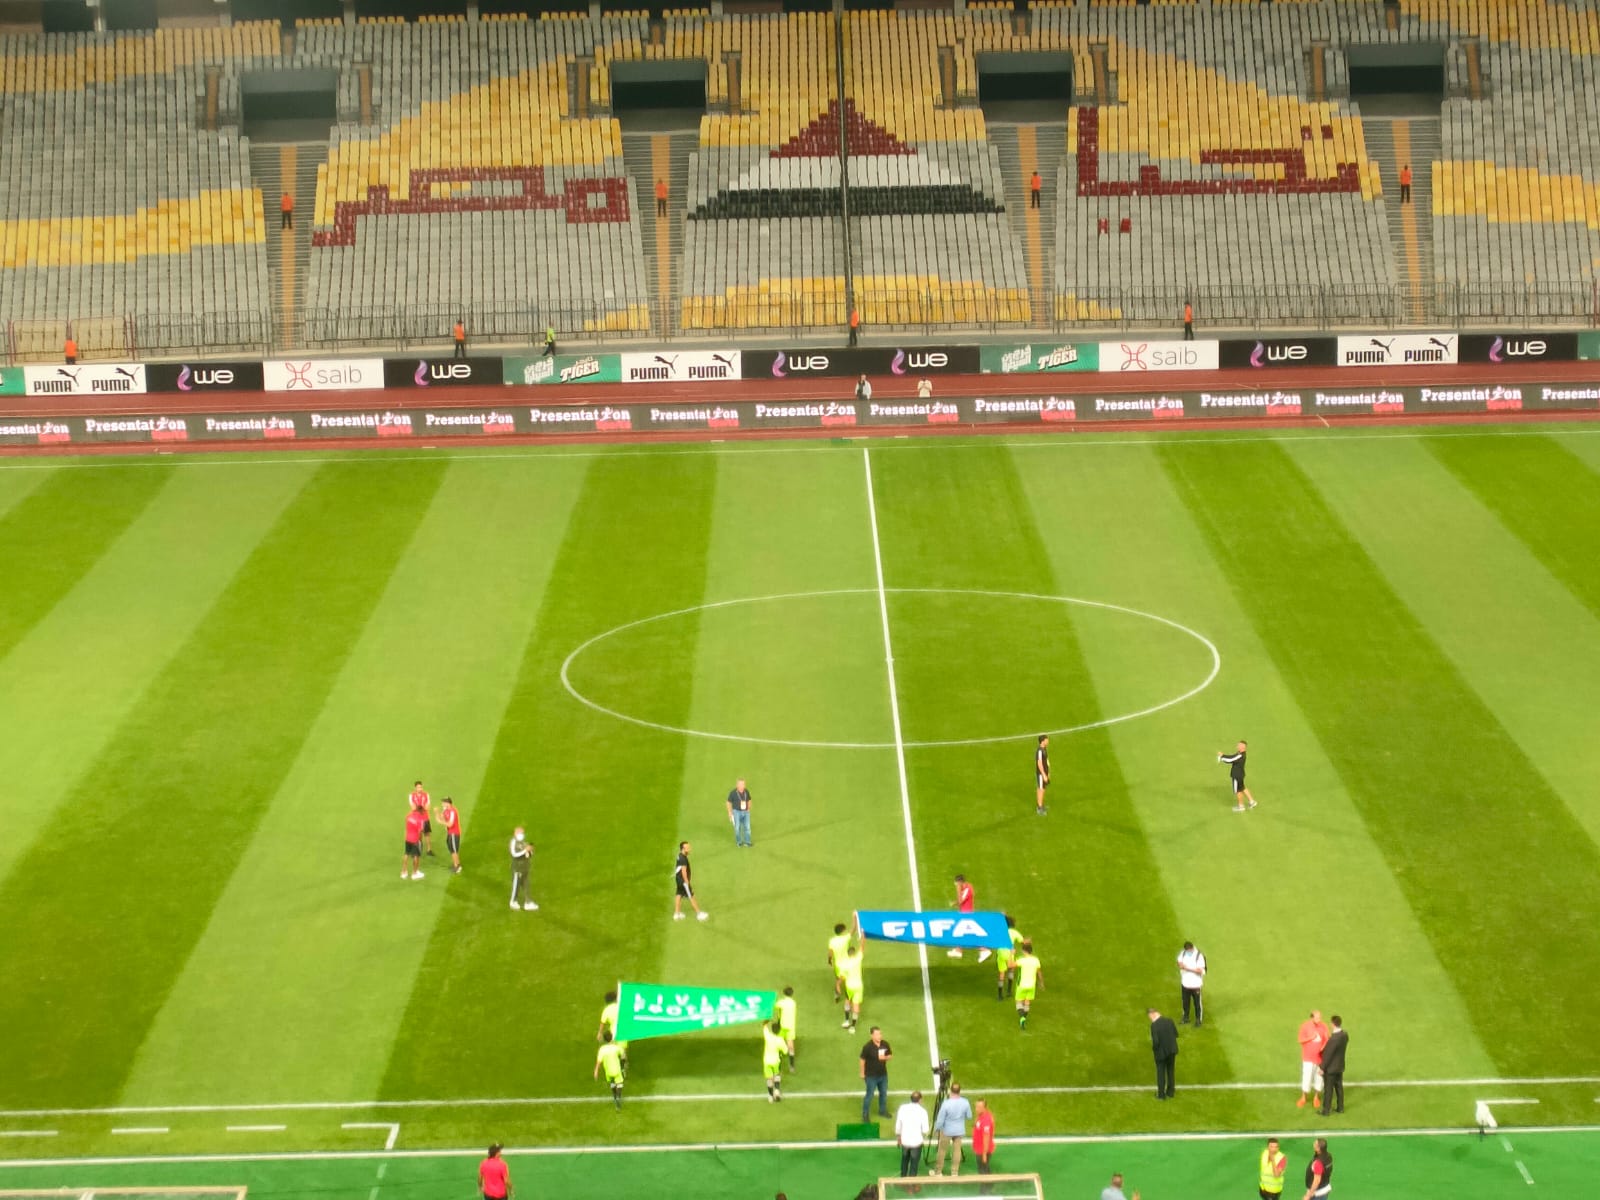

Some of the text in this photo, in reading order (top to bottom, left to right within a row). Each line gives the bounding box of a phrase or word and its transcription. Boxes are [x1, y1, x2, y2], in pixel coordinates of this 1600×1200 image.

[1037, 349, 1078, 371] TIGER
[1152, 347, 1198, 366] saib
[1346, 350, 1443, 363] PUMA PUMA
[316, 365, 362, 385] saib
[560, 360, 600, 383] TIGER
[630, 365, 727, 380] PUMA PUMA
[34, 379, 131, 393] PUMA PUMA
[882, 919, 988, 938] FIFA
